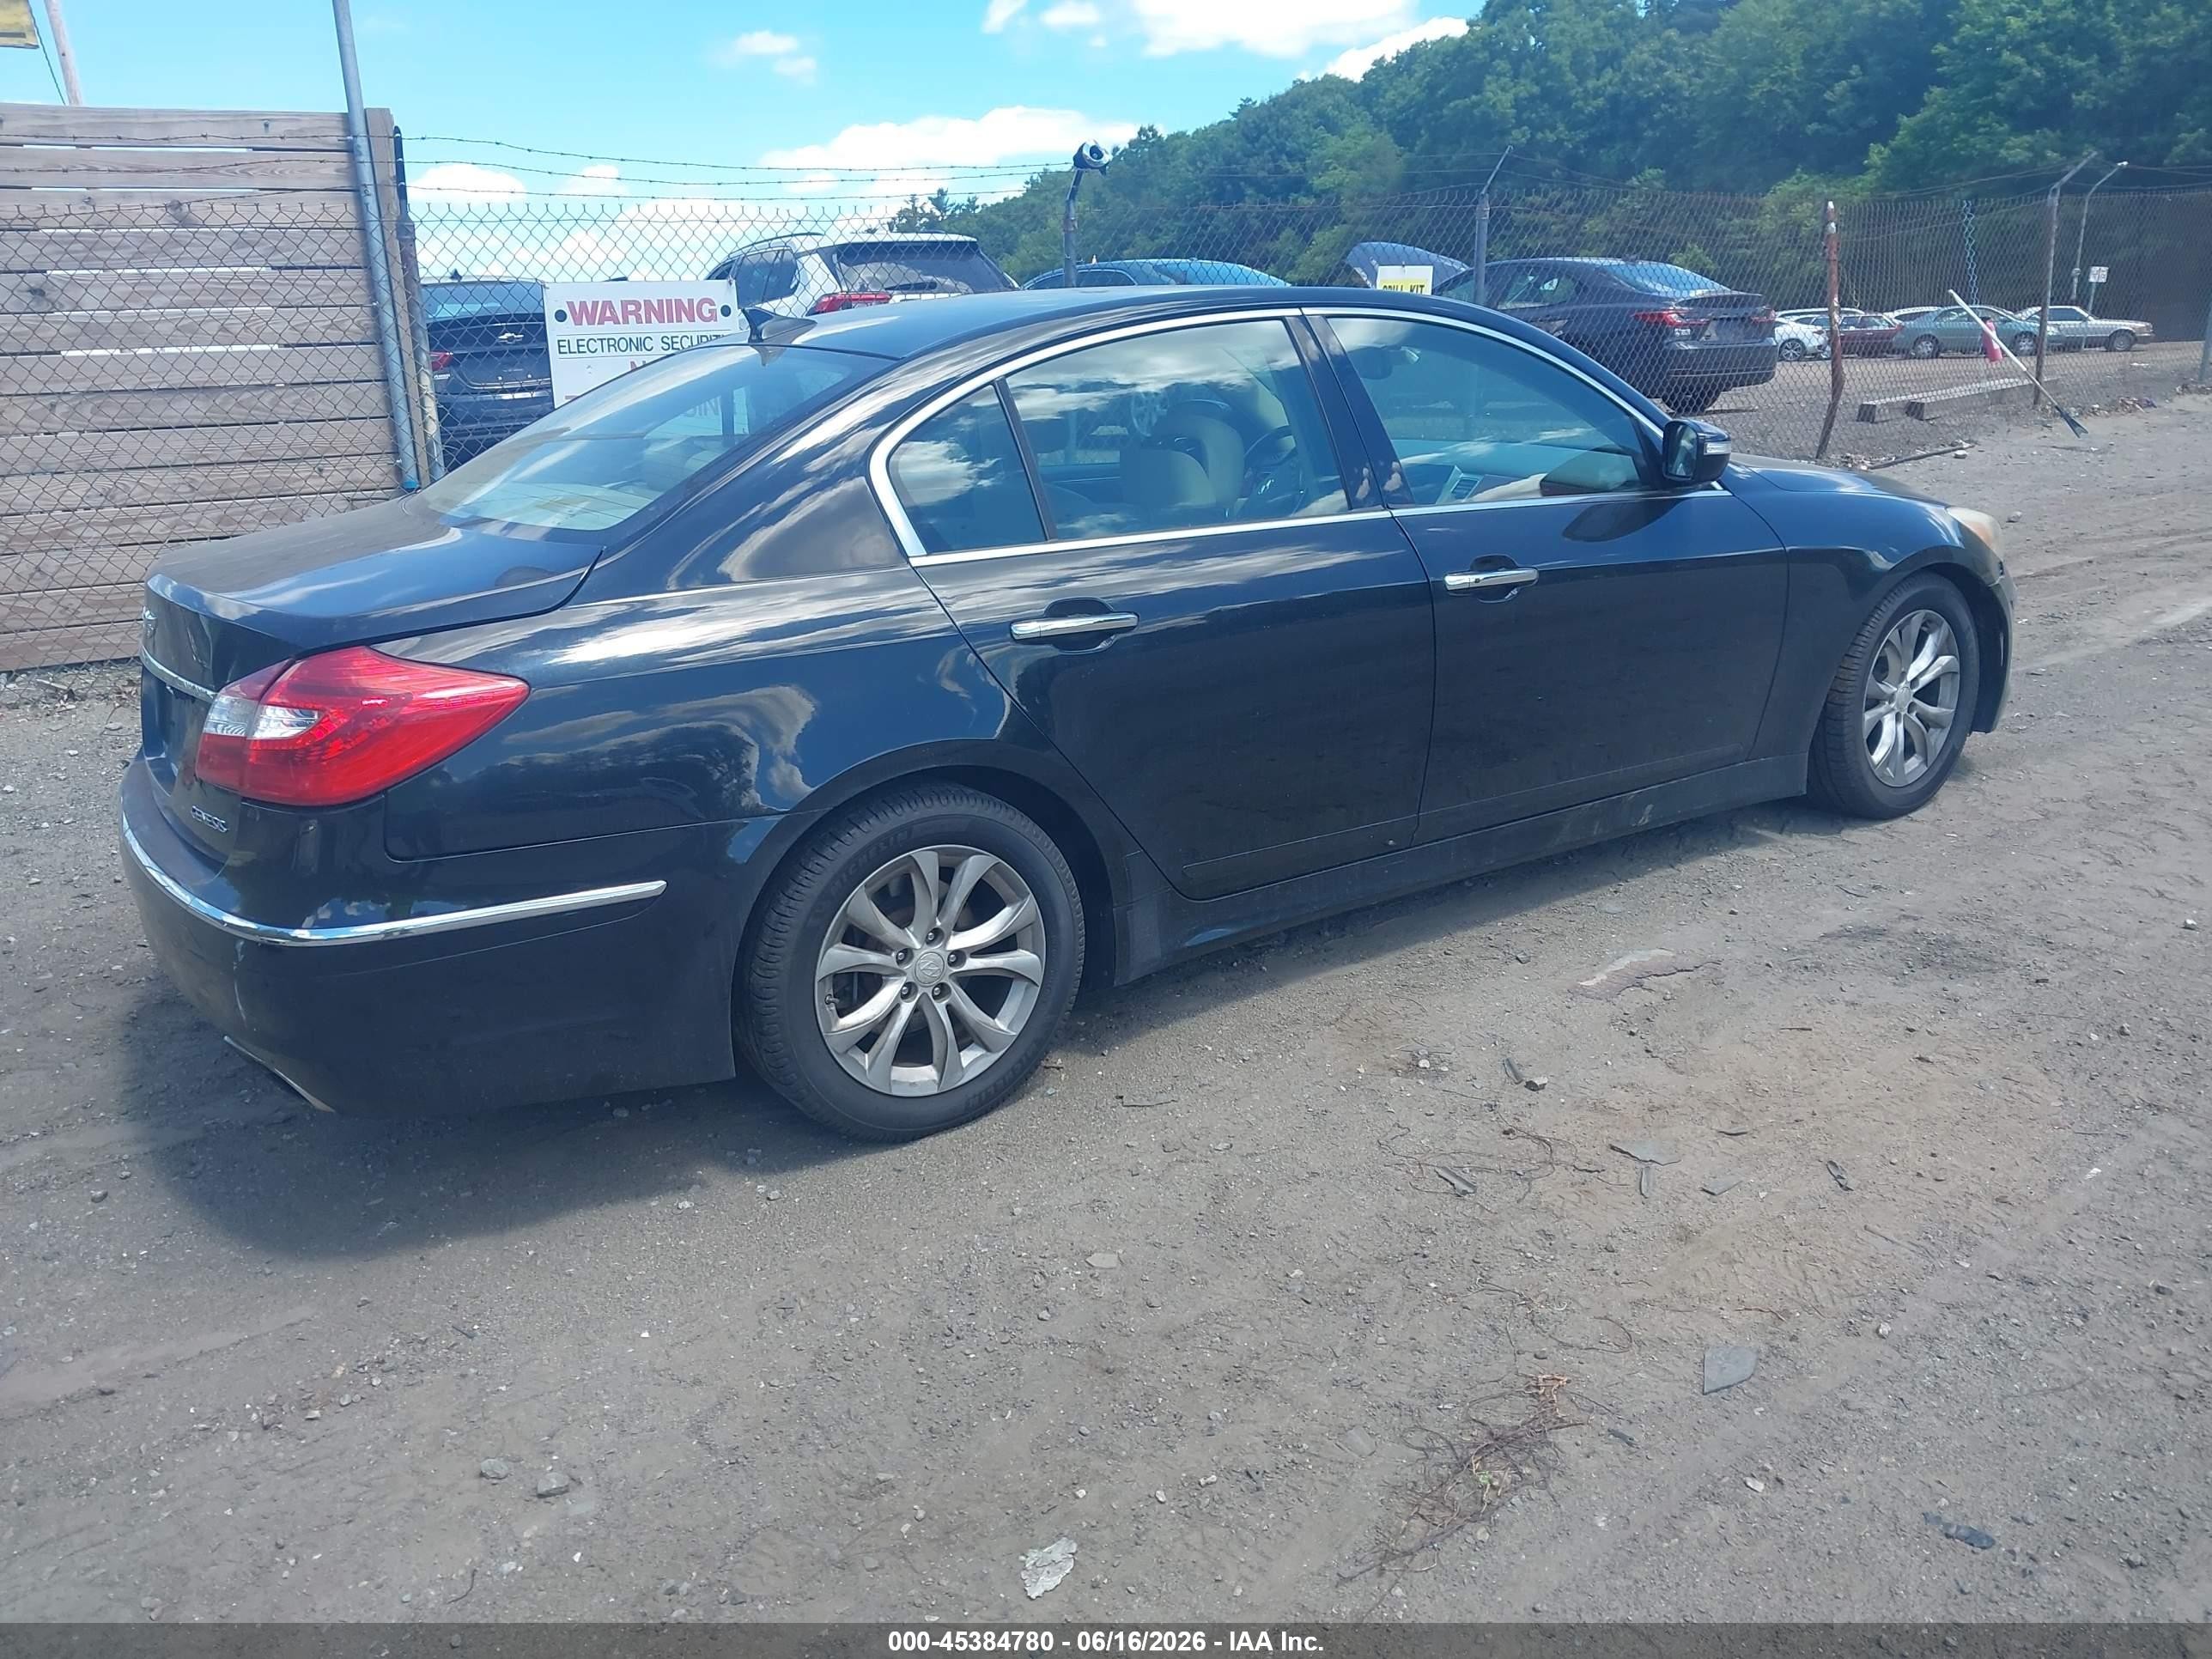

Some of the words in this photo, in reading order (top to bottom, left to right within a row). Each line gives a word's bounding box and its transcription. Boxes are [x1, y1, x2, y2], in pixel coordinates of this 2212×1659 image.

[1409, 284, 1425, 295] KIT
[566, 297, 718, 326] WARNING
[556, 336, 653, 355] ELECTRONIC
[660, 334, 725, 351] SECUR
